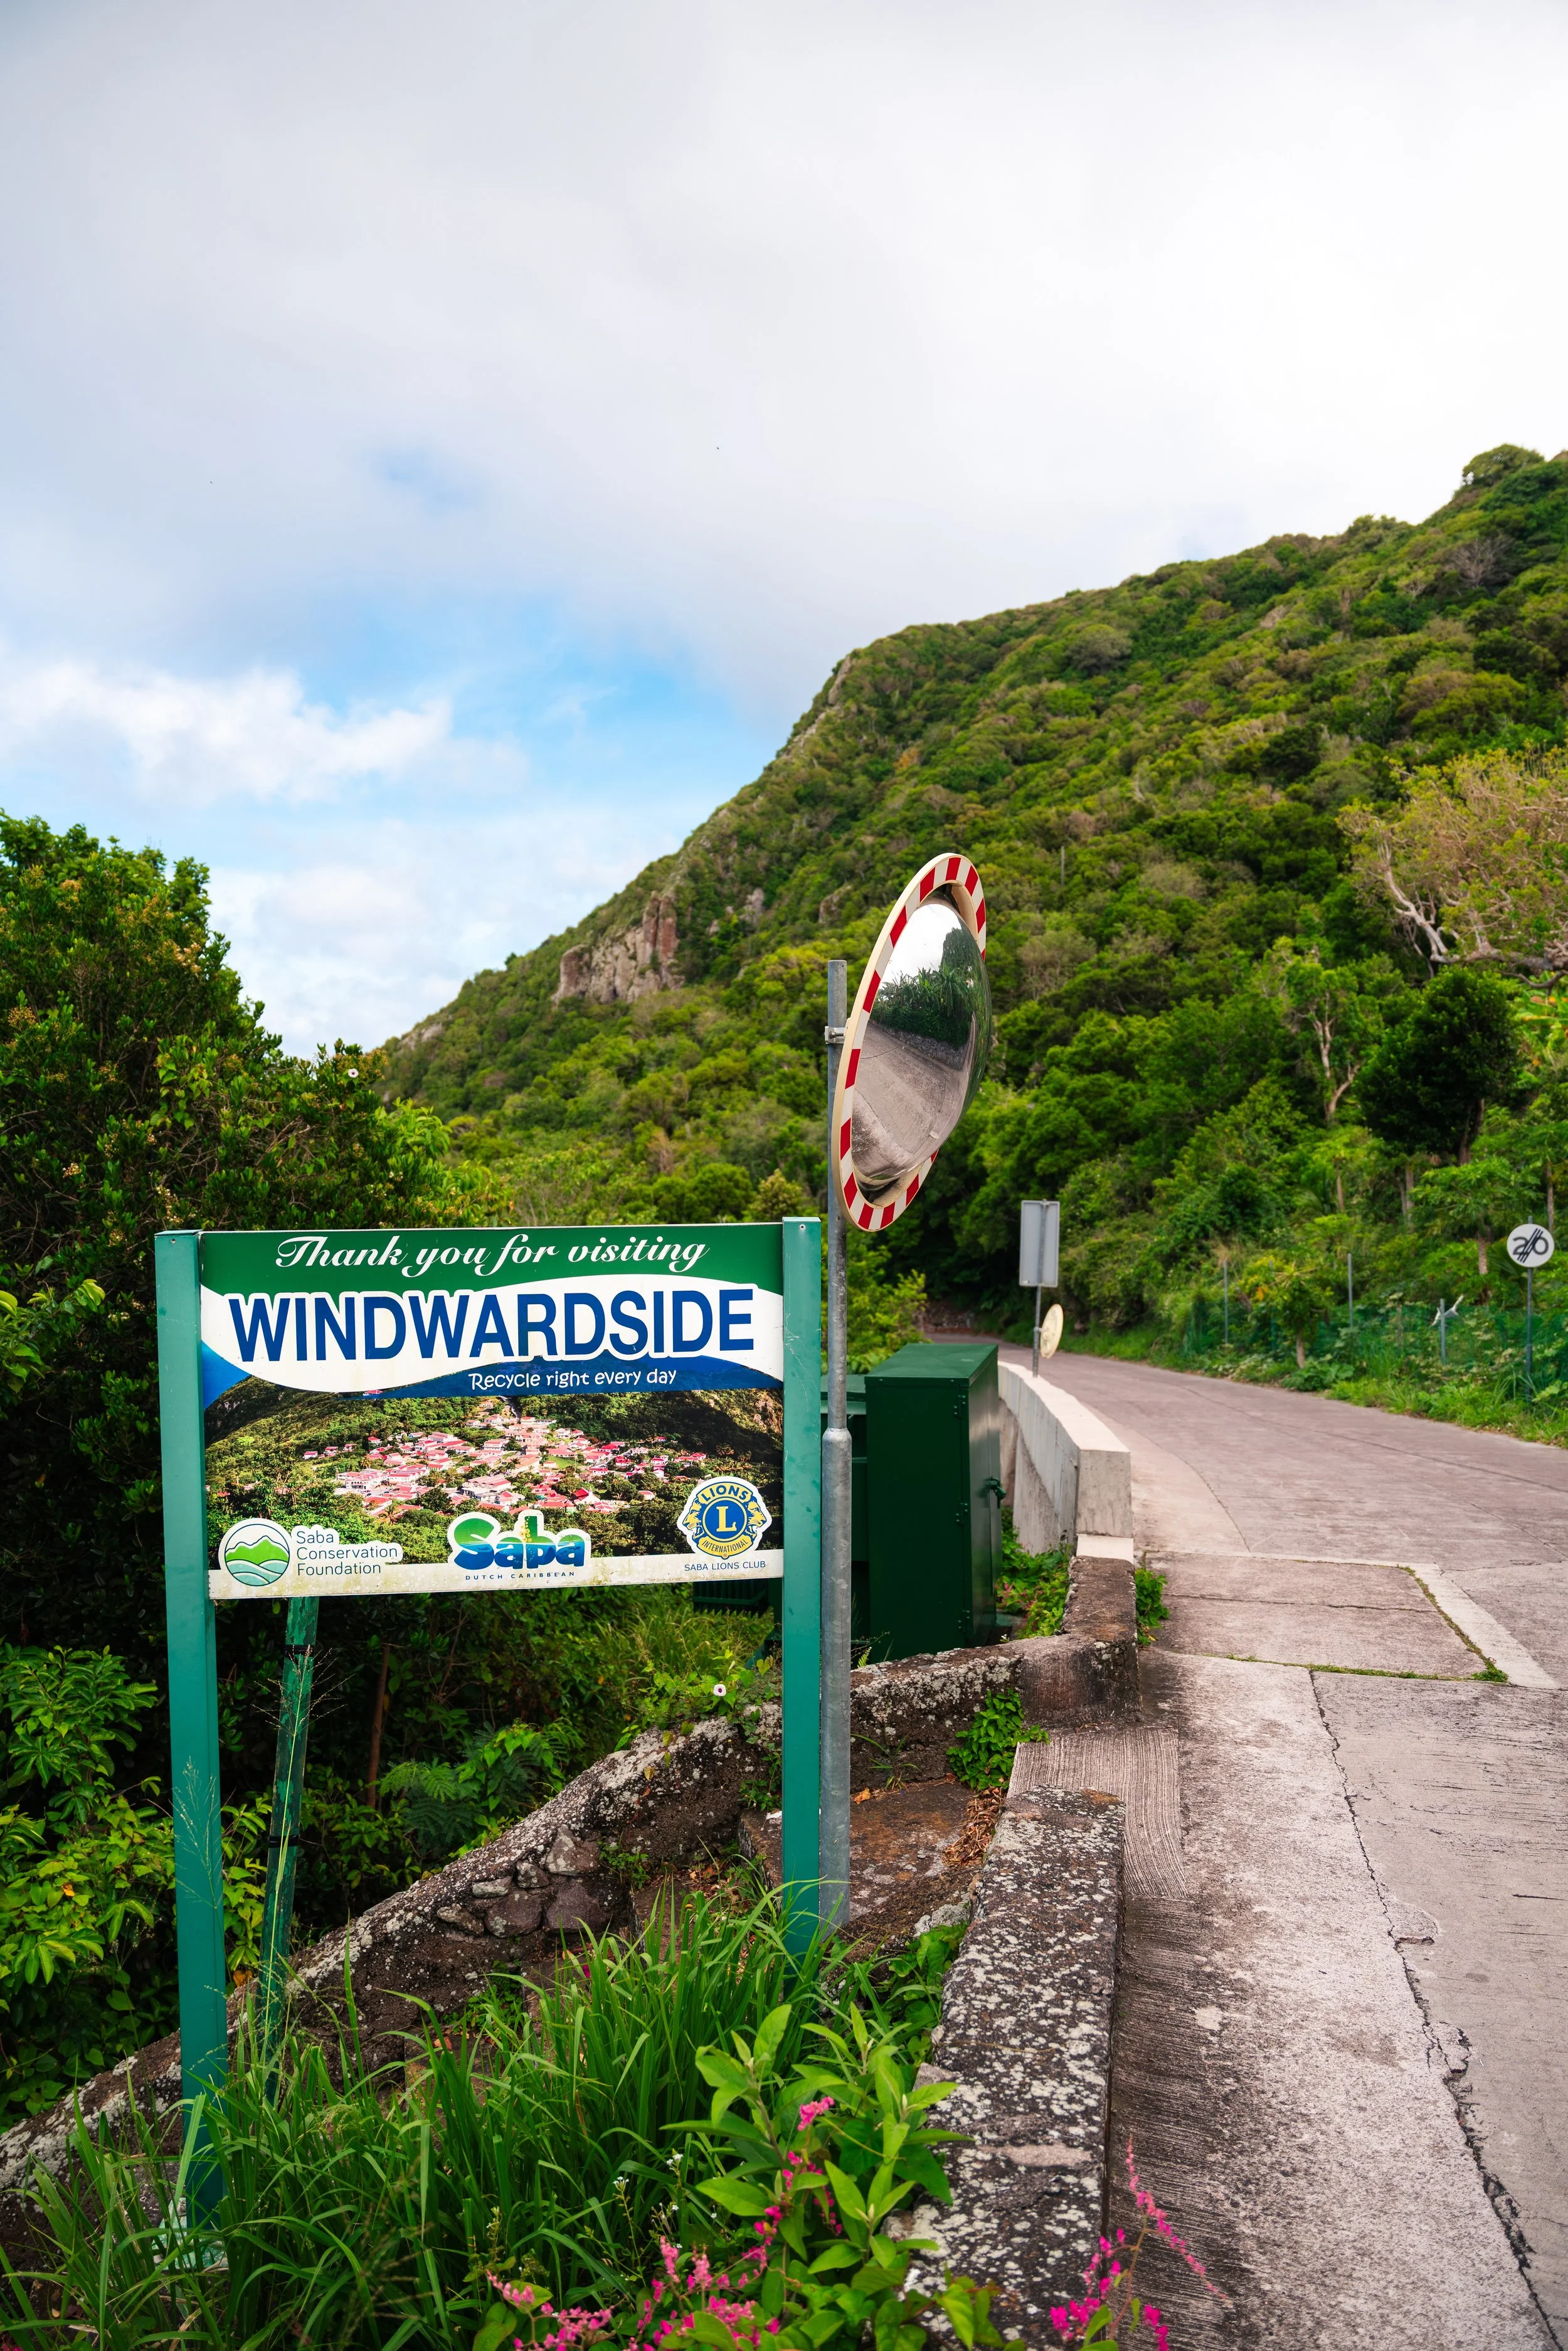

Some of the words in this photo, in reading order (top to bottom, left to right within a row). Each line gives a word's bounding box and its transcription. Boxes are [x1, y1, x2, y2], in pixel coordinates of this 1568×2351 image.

[1512, 1236, 1549, 1255] 20
[275, 1236, 408, 1267] Thank
[401, 1247, 491, 1278] you
[475, 1234, 559, 1276] for
[568, 1236, 710, 1273] visiting
[228, 1288, 754, 1362] WINDWARDSIDE
[468, 1372, 540, 1390] Recycle
[546, 1371, 590, 1388] right
[595, 1371, 641, 1385] every
[647, 1368, 677, 1384] day
[701, 1485, 749, 1502] LIONS
[716, 1506, 737, 1532] L
[296, 1530, 334, 1544] Saba
[453, 1515, 585, 1570] Saba
[701, 1539, 748, 1553] INTERNATIONAL
[297, 1546, 398, 1561] Conservation
[297, 1562, 381, 1576] Foundation
[684, 1563, 708, 1571] SABA
[711, 1562, 739, 1570] LIONS
[743, 1561, 766, 1569] CLUB
